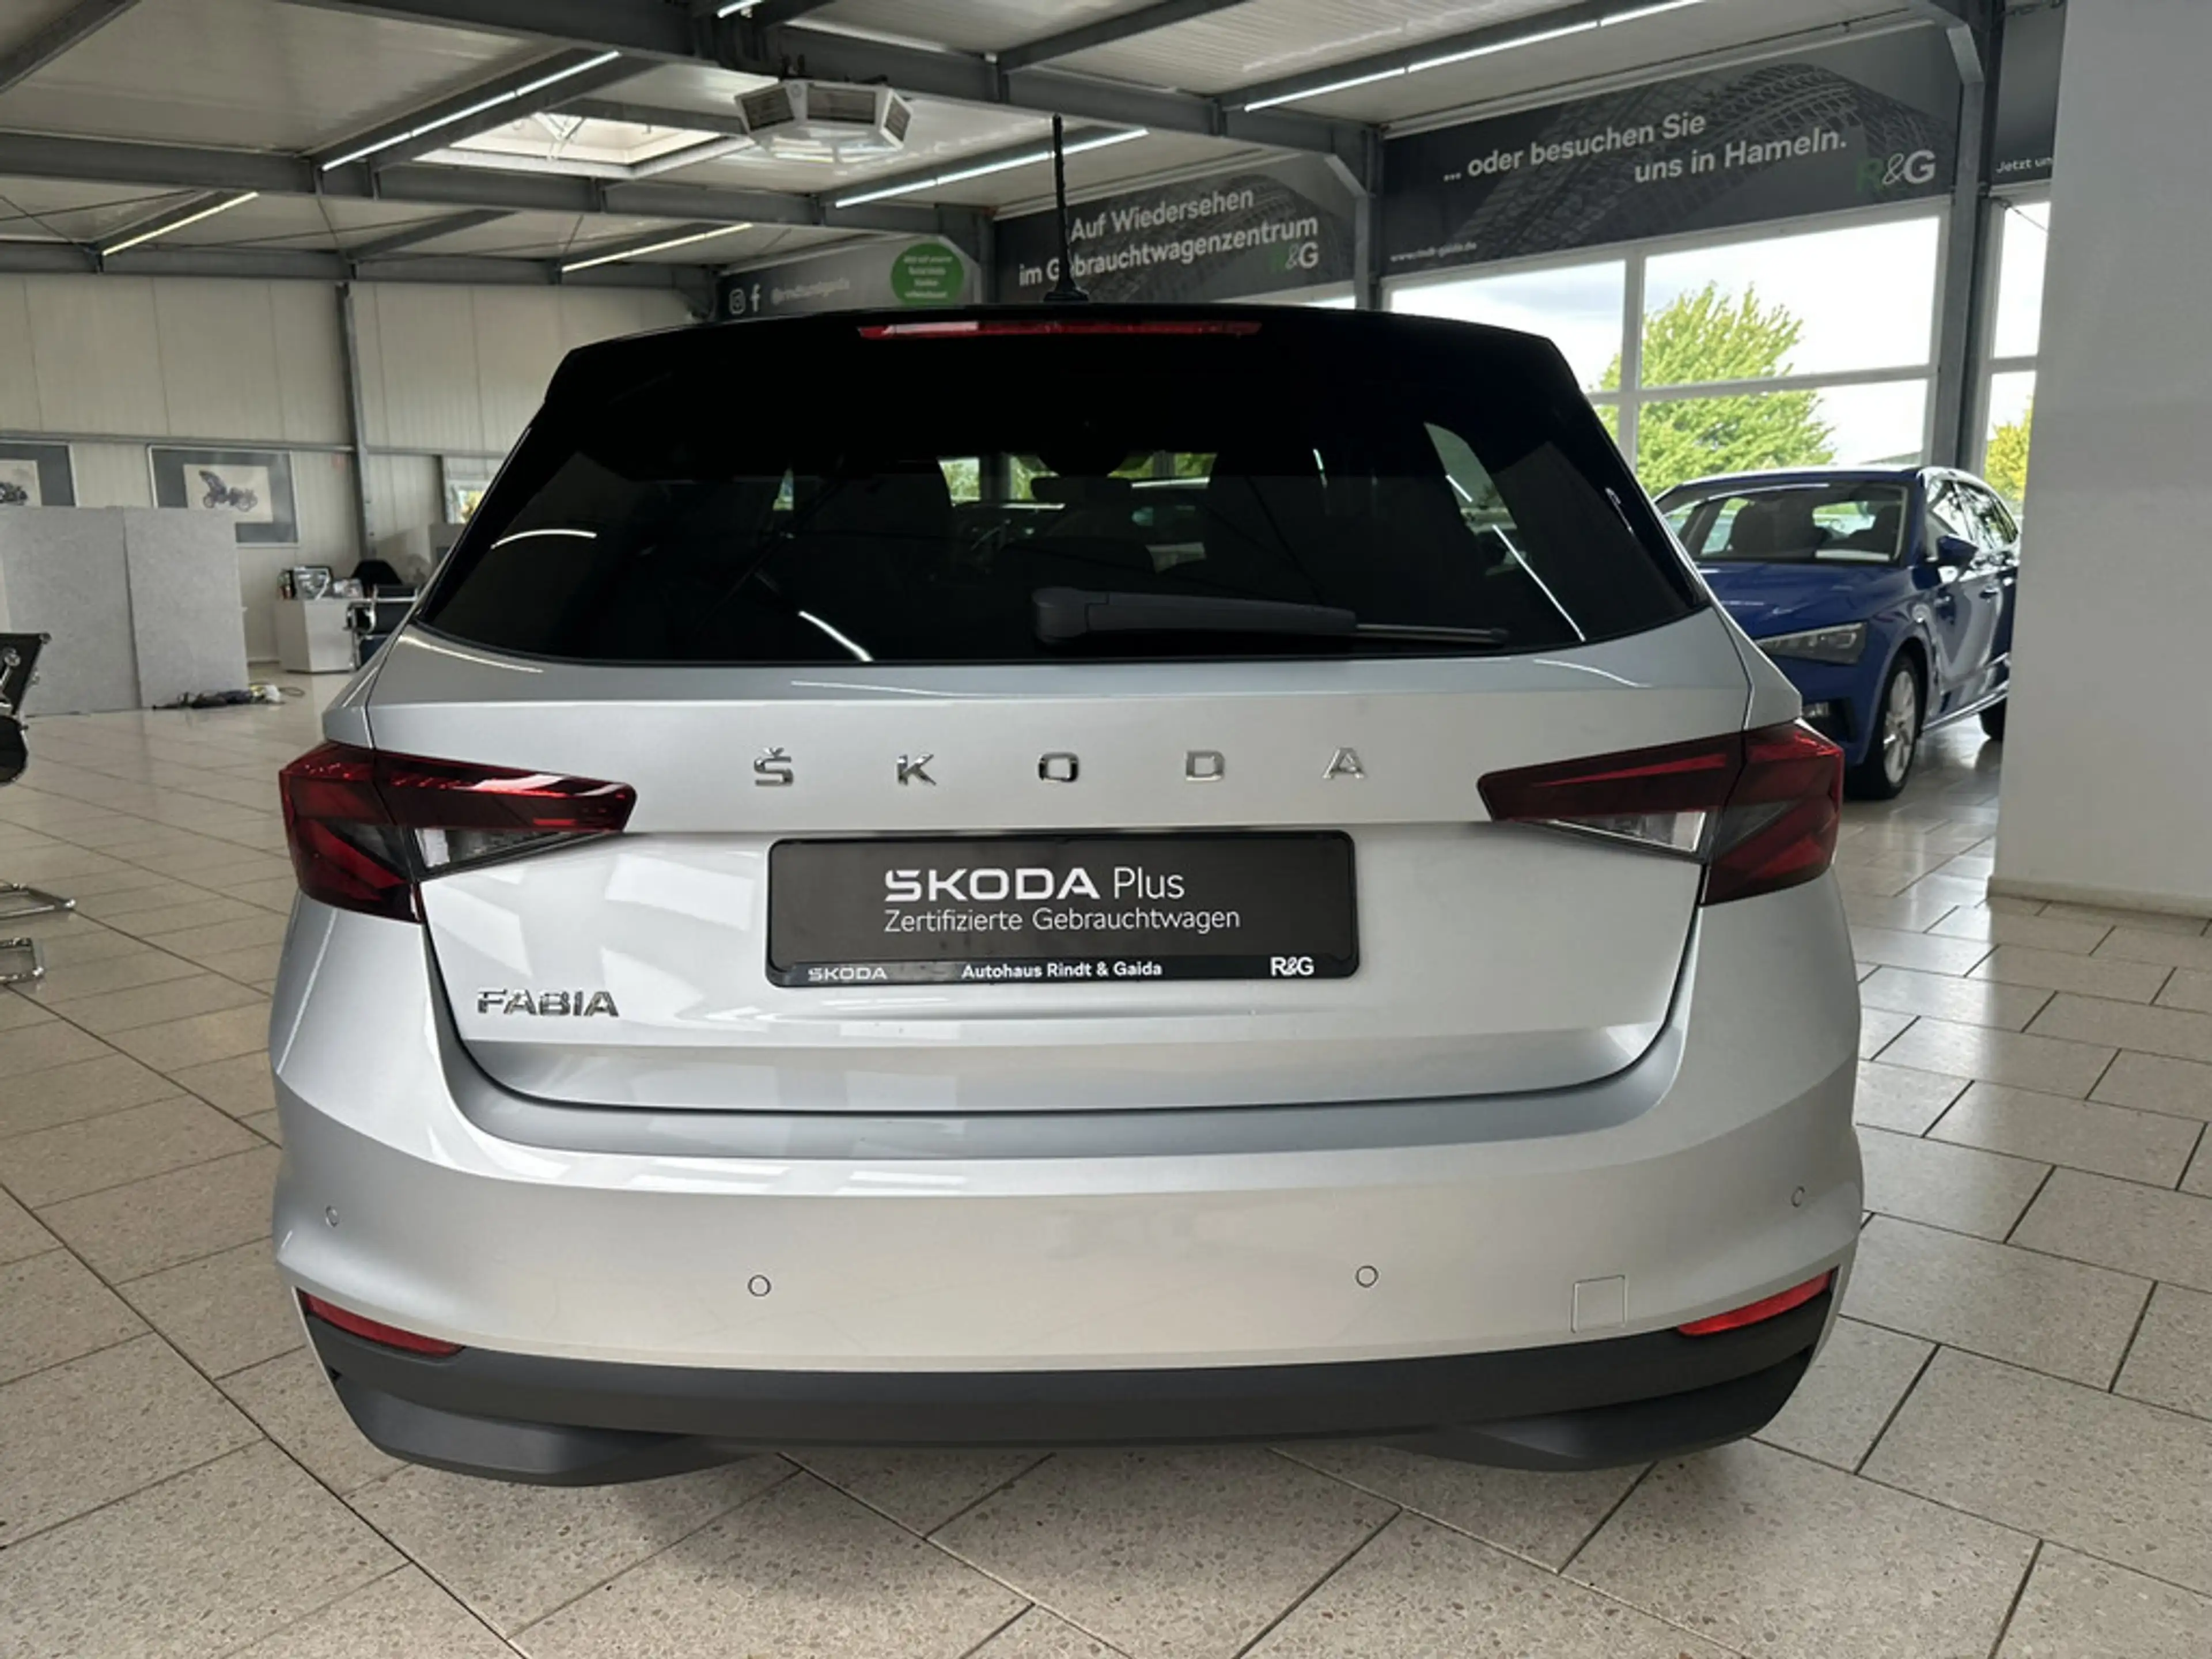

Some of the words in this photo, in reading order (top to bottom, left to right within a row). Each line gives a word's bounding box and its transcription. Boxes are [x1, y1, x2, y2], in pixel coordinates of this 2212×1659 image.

[1468, 149, 1524, 176] oder
[1531, 124, 1654, 165] besuchen
[1662, 112, 1706, 139] Sie
[1635, 157, 1683, 183] uns
[1691, 148, 1715, 173] in
[1725, 127, 1847, 168] Hameln.
[1995, 158, 2032, 174] Jetzt
[1070, 213, 1108, 242] Auf
[1111, 188, 1254, 233] Wiedersehen
[1019, 263, 1043, 287] im
[1113, 866, 1185, 900] Plus
[884, 908, 1022, 932] Zertifizierte
[1032, 907, 1240, 935] Gebrauchtwagen
[962, 964, 1041, 979] Autohaus
[1047, 963, 1092, 978] Rindt
[1096, 964, 1108, 977] &
[1113, 961, 1162, 976] Gaida
[1270, 956, 1315, 976] R&G
[477, 988, 619, 1017] FABIA
